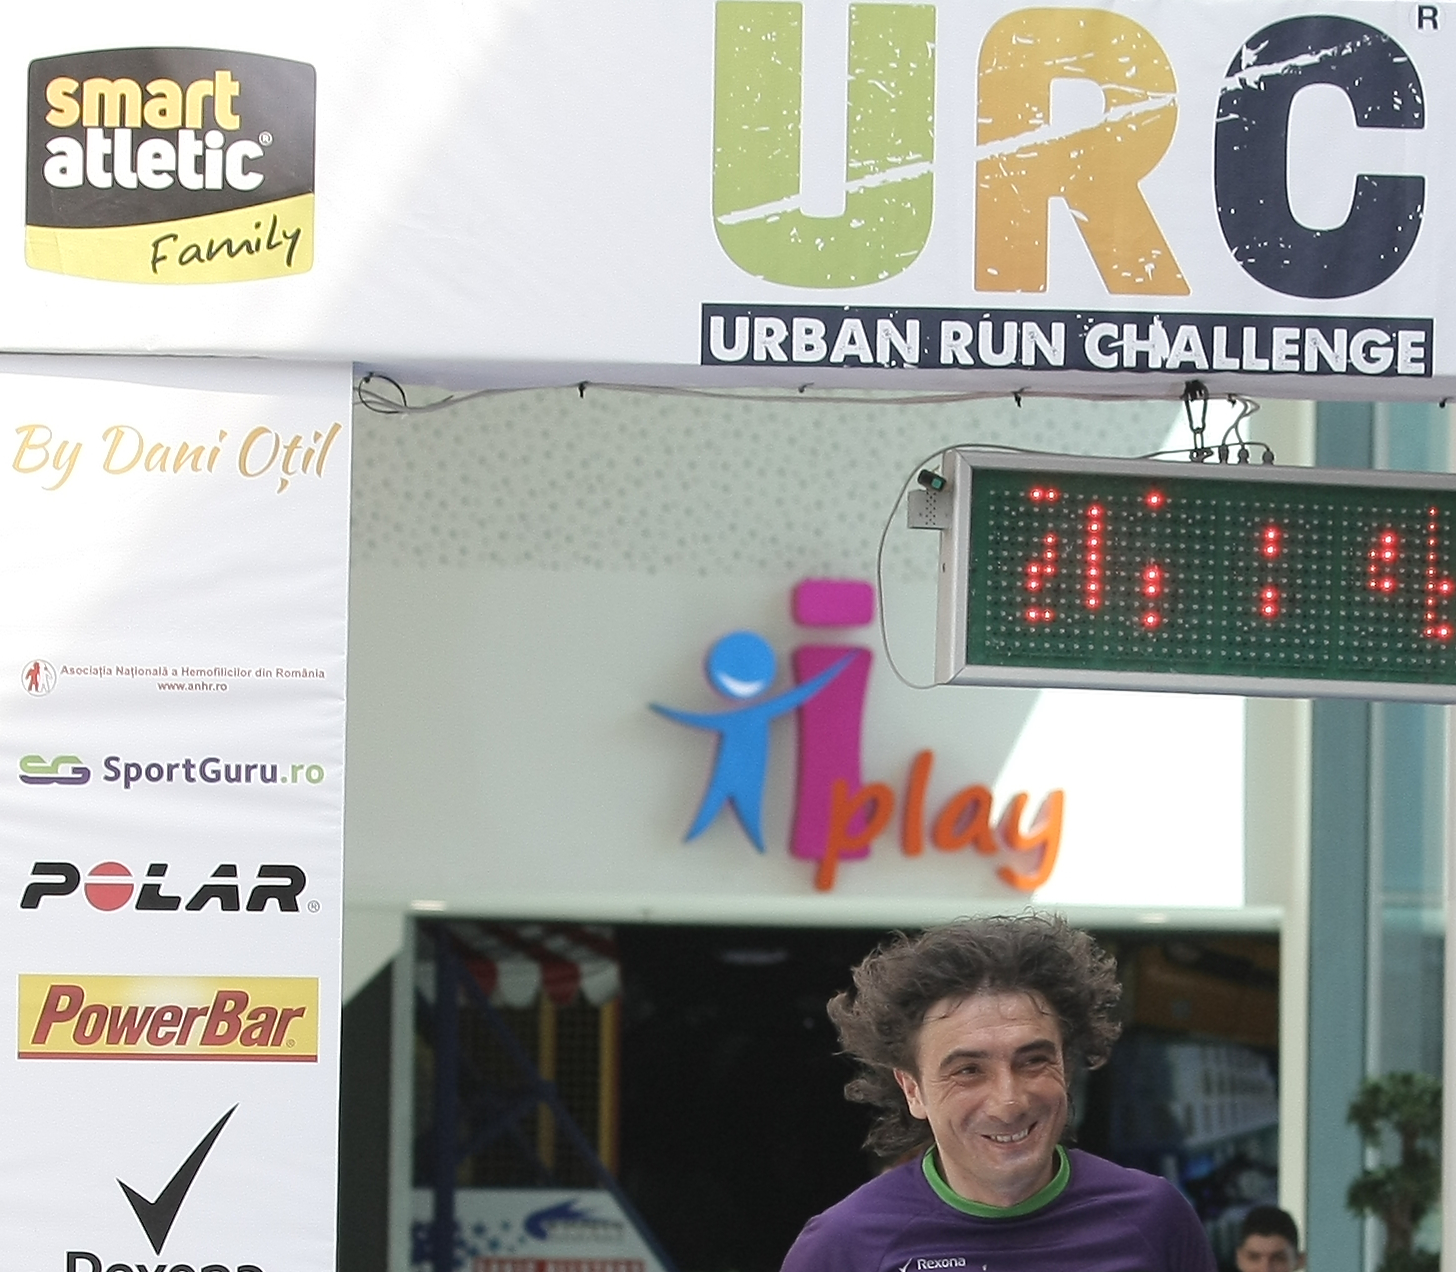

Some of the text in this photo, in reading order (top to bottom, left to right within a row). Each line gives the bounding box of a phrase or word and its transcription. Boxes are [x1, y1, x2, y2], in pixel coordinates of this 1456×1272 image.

[45, 70, 240, 130] smart
[713, 1, 1426, 299] URC
[150, 214, 302, 275] Family
[708, 315, 1428, 376] URBAN RUN CHALLENGE
[12, 424, 83, 491] By
[102, 425, 223, 476] Dani
[157, 680, 228, 691] www.anhr.ro
[171, 668, 178, 677] a
[180, 666, 252, 678] Hemofilicilor
[254, 667, 273, 679] din
[275, 666, 325, 679] România
[103, 756, 325, 789] SportGuru.ro
[814, 748, 1065, 892] play
[20, 861, 307, 912] POLAR
[31, 984, 307, 1049] PowerBar
[917, 1257, 966, 1271] Rexona
